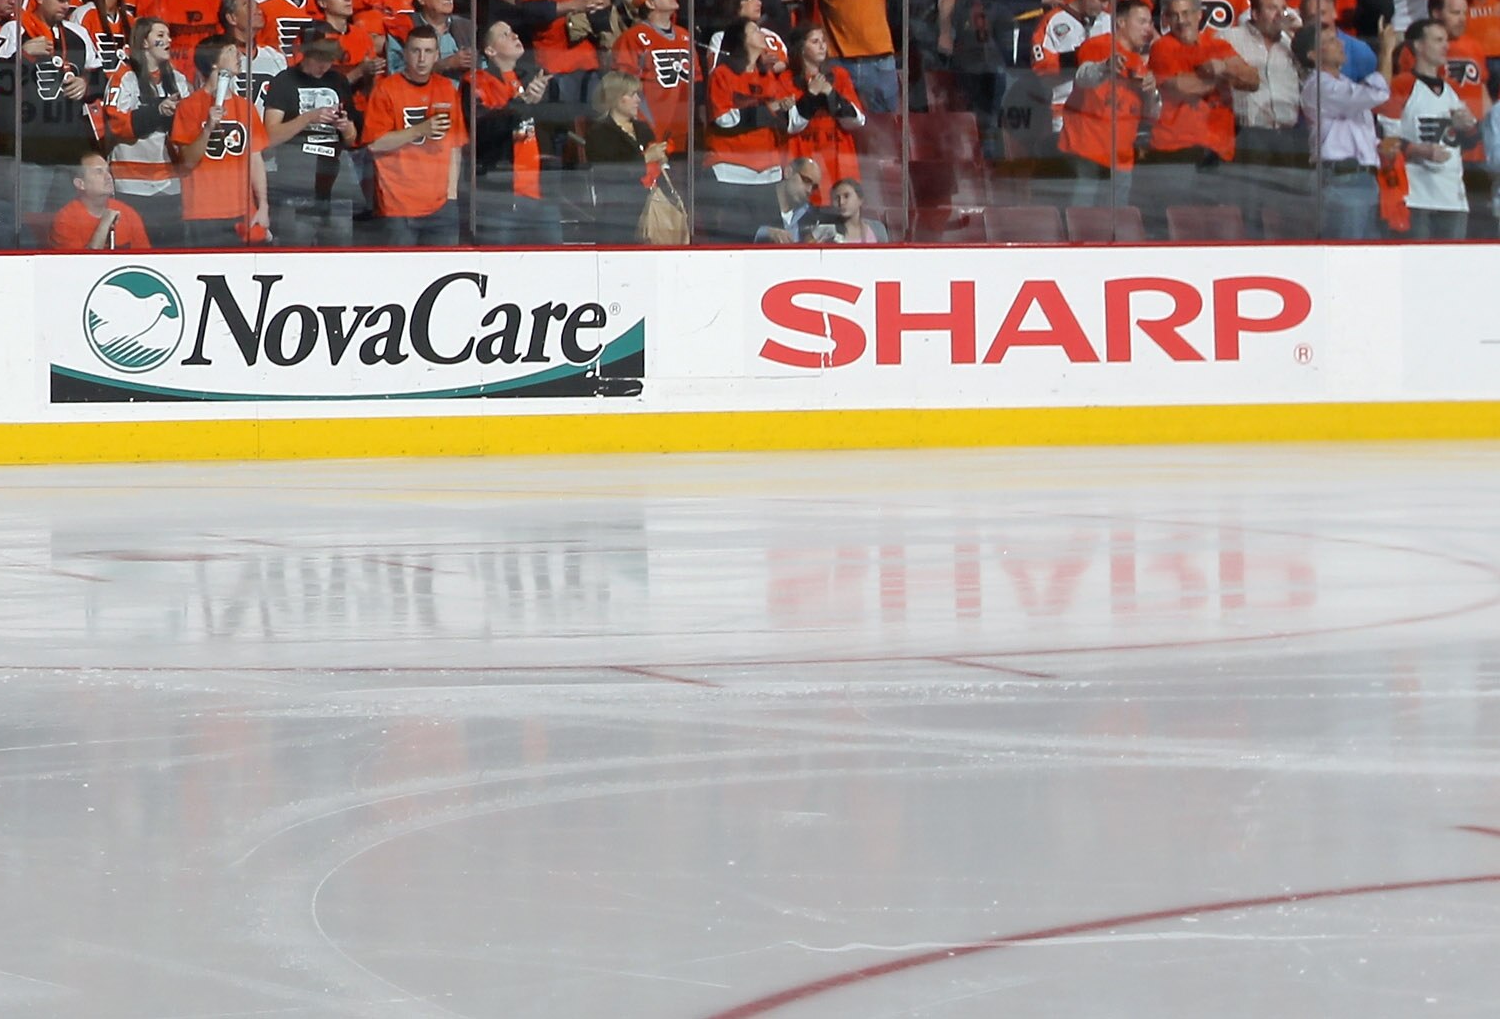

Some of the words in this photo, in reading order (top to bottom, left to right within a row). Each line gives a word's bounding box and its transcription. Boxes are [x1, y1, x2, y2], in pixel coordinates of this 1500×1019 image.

[637, 32, 651, 46] C
[764, 35, 778, 51] C
[181, 272, 607, 366] NovaCare
[758, 277, 1313, 370] SHARP
